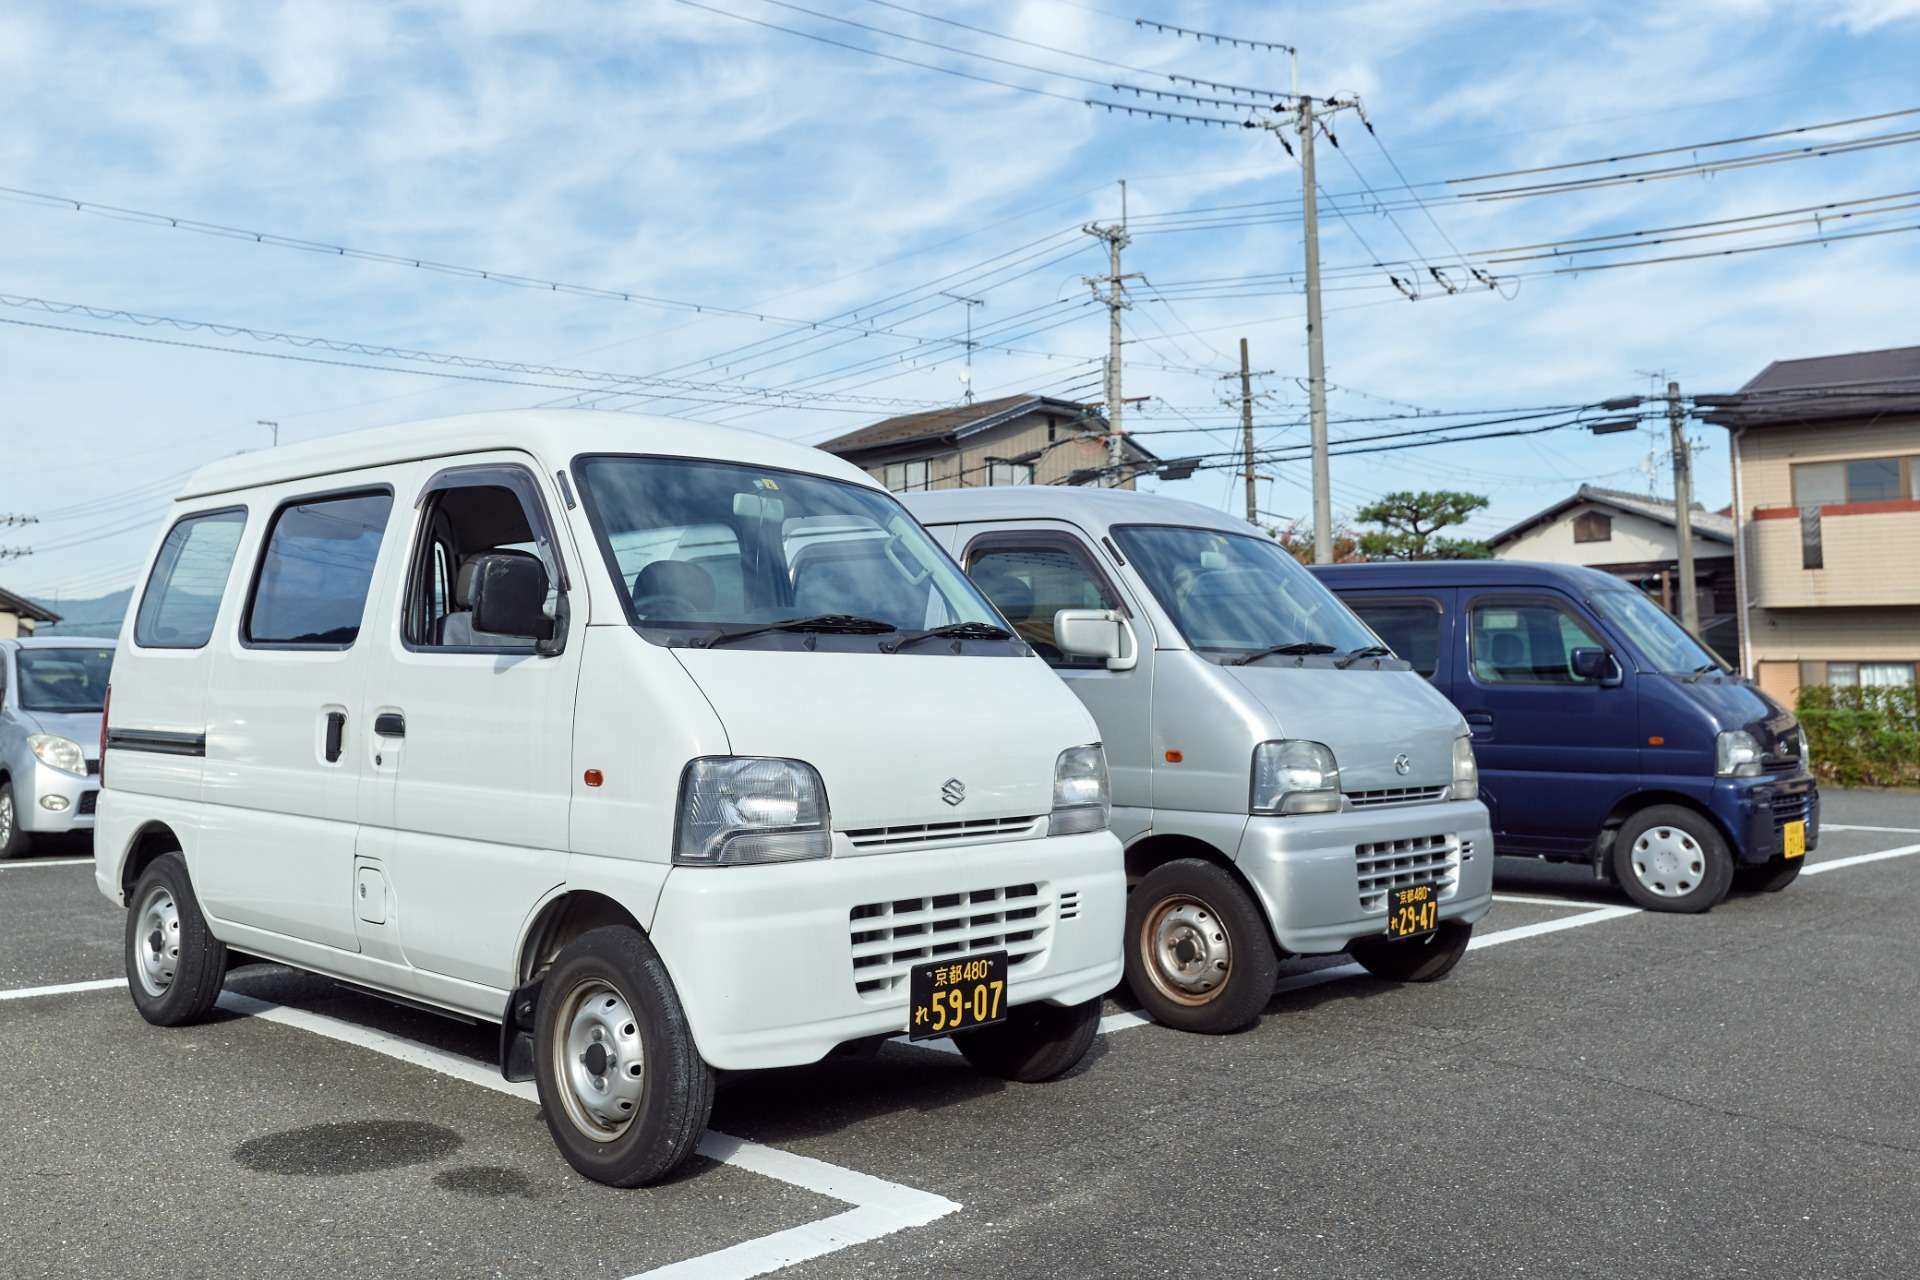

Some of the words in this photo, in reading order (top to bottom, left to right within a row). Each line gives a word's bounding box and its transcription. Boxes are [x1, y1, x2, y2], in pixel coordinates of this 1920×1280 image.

[1399, 901, 1436, 936] 29-47
[915, 1005, 930, 1025] れ
[932, 980, 1003, 1031] 59-07
